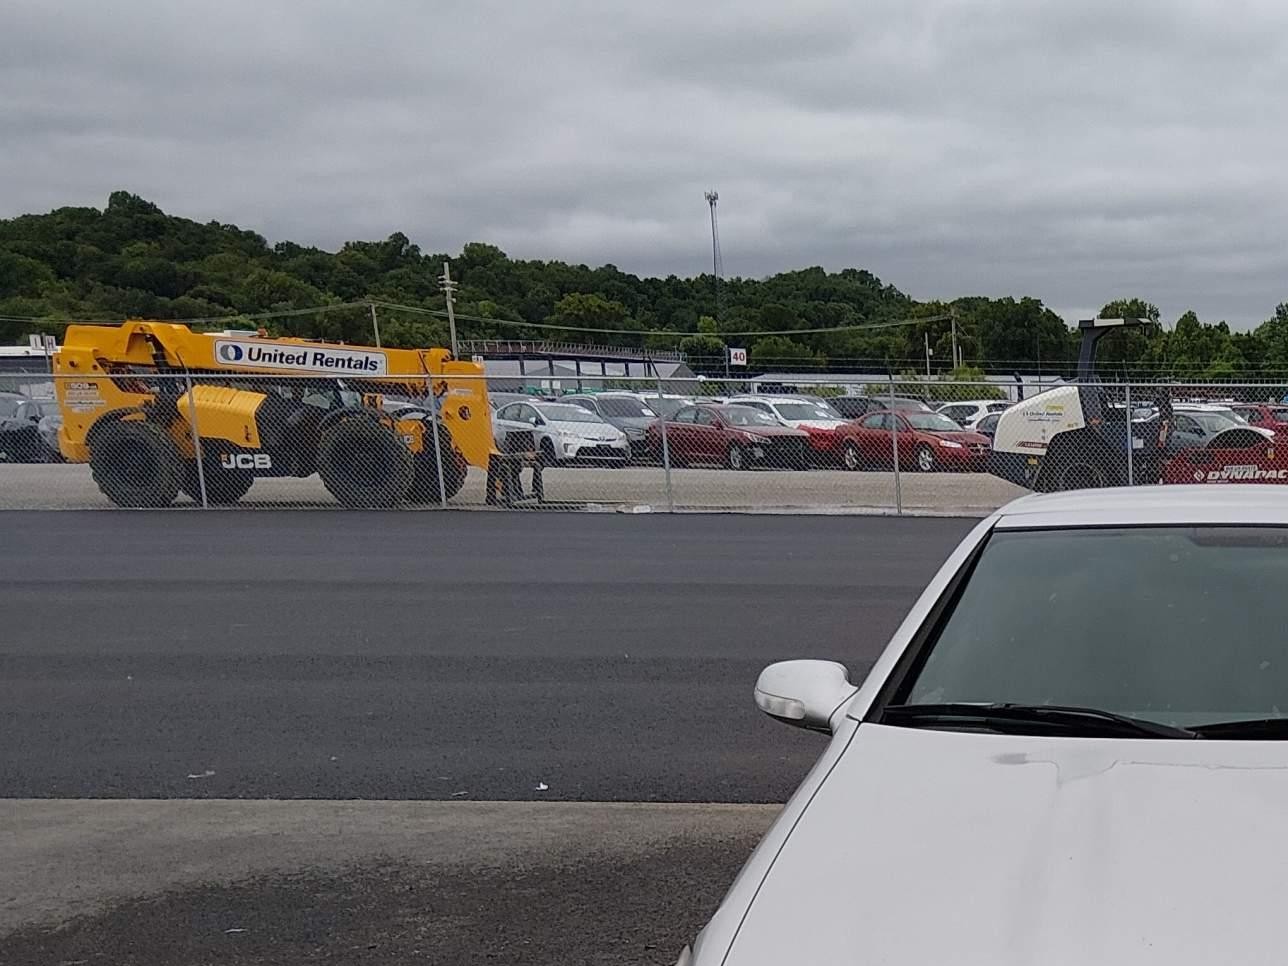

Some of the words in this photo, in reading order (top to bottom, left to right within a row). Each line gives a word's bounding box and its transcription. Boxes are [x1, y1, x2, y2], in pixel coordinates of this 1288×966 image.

[248, 347, 308, 365] United
[312, 352, 378, 371] Rentals
[732, 352, 745, 362] 40
[220, 453, 272, 469] JCB
